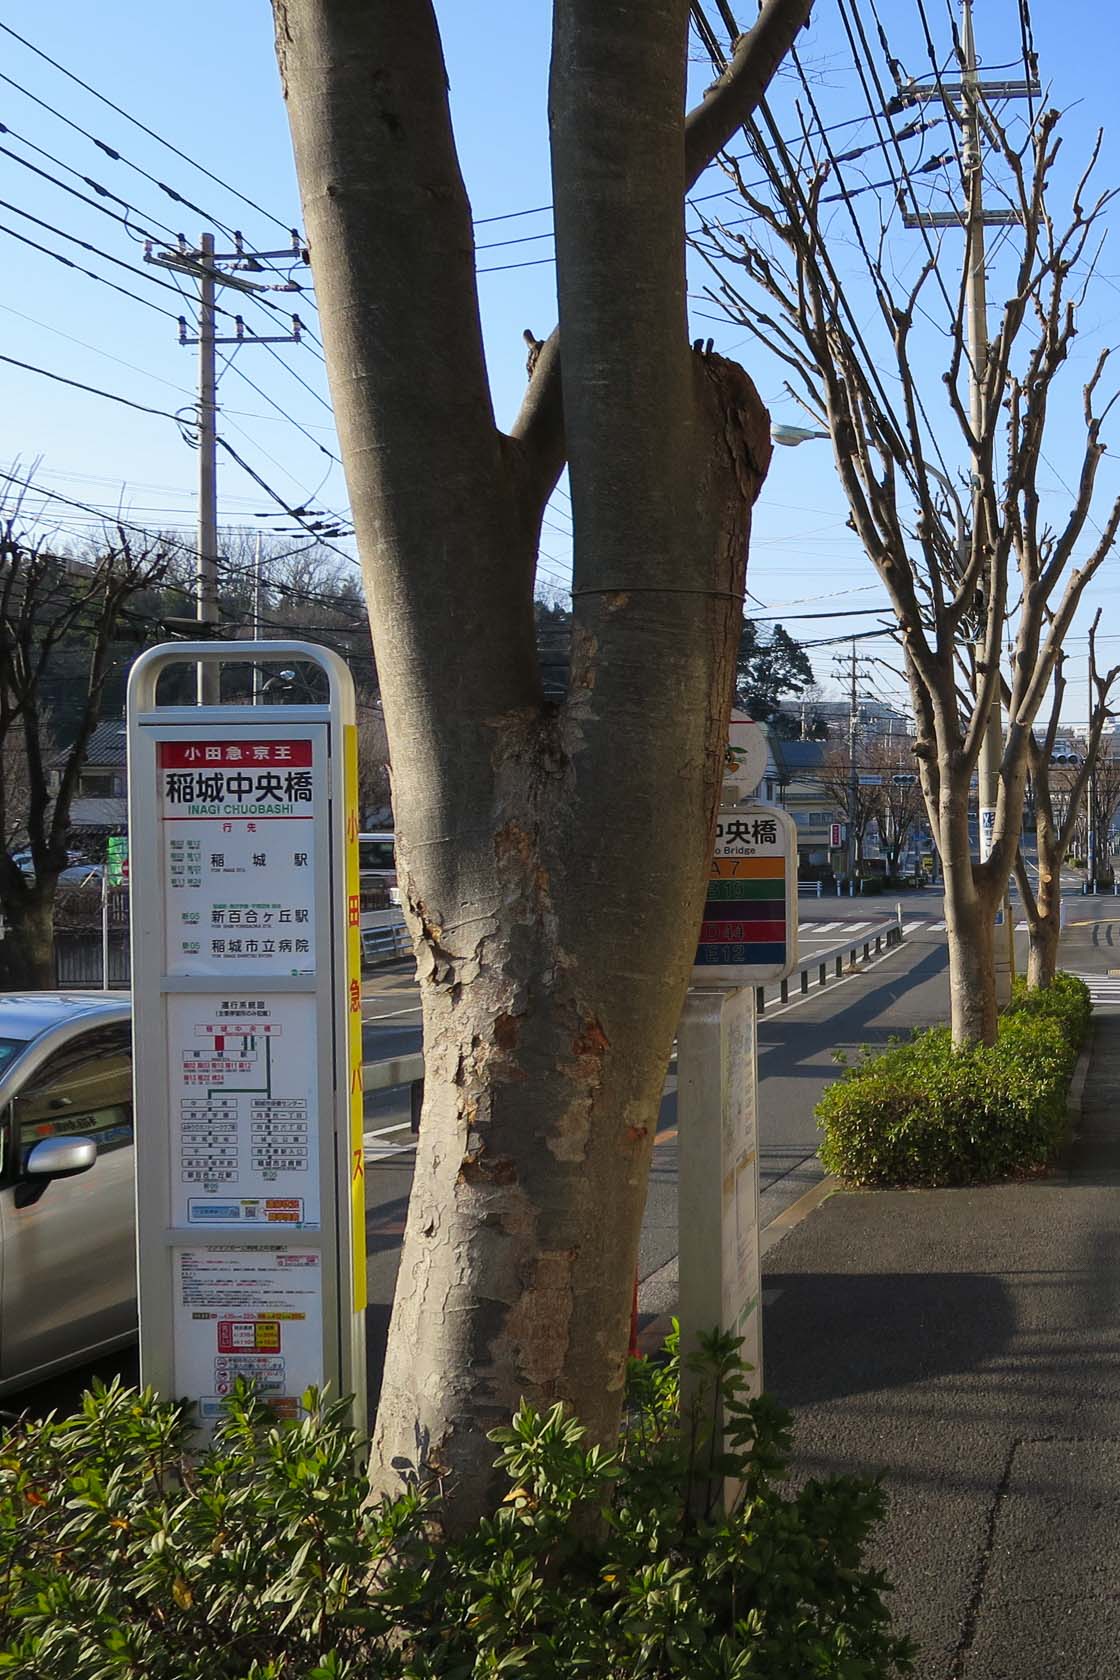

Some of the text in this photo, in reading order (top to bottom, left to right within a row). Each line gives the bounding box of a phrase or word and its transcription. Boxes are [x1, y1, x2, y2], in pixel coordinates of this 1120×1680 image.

[184, 746, 292, 760] 小田急・京王
[166, 771, 313, 803] 稲城中央橋
[188, 804, 293, 815] INAGI CHUOBASHI
[723, 846, 756, 855] Bridge
[211, 909, 309, 923] 新百合ヶ丘駅
[211, 939, 310, 953] 稲城市立病院
[347, 809, 364, 1180] 小田急バス
